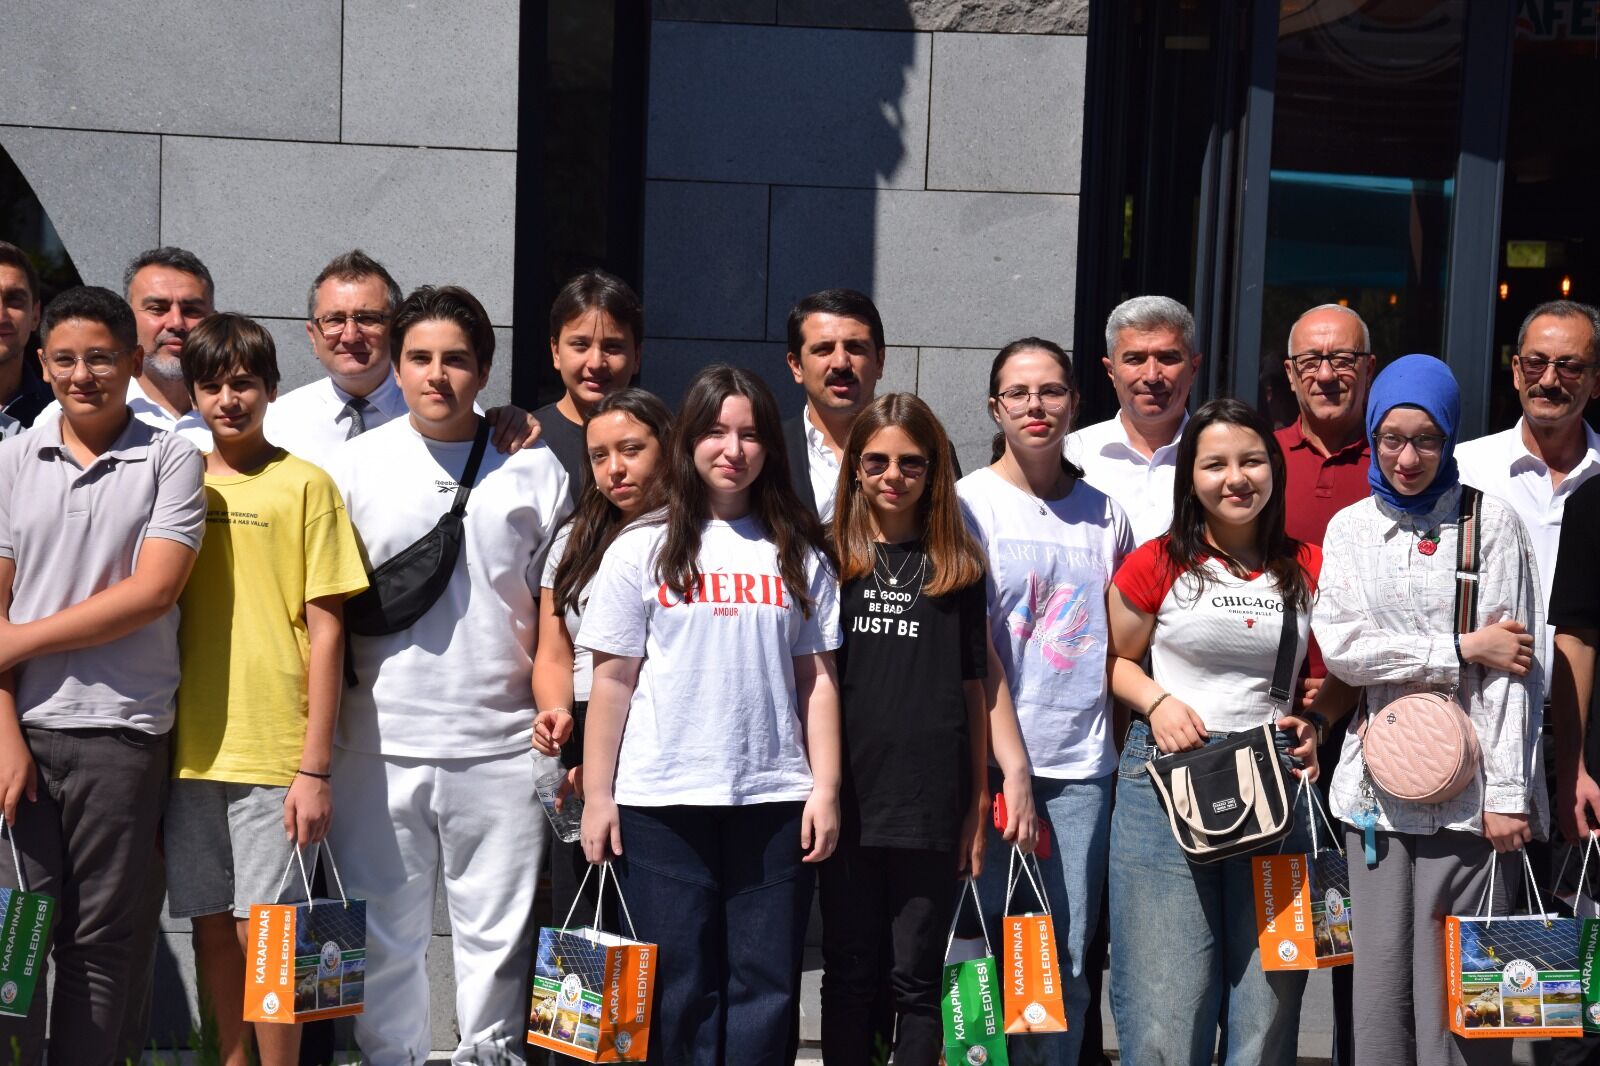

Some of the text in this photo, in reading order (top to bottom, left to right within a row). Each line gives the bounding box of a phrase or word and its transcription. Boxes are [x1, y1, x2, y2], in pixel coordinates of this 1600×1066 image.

[1006, 543, 1039, 561] ART
[713, 607, 739, 617] AMOUR
[852, 616, 920, 638] JUST BE
[863, 589, 912, 602] BE GOOD
[868, 602, 904, 614] BE BAD
[1211, 595, 1285, 613] CHICAGO
[1262, 860, 1276, 933] KARAPINAR
[2, 896, 25, 972] KARAPINAR
[255, 910, 271, 984] KARAPINAR
[1013, 922, 1025, 995] KARAPINAR
[1448, 922, 1456, 995] KARAPINAR
[610, 950, 623, 1025] KARAPINAR
[950, 967, 966, 1040] KARAPINAR
